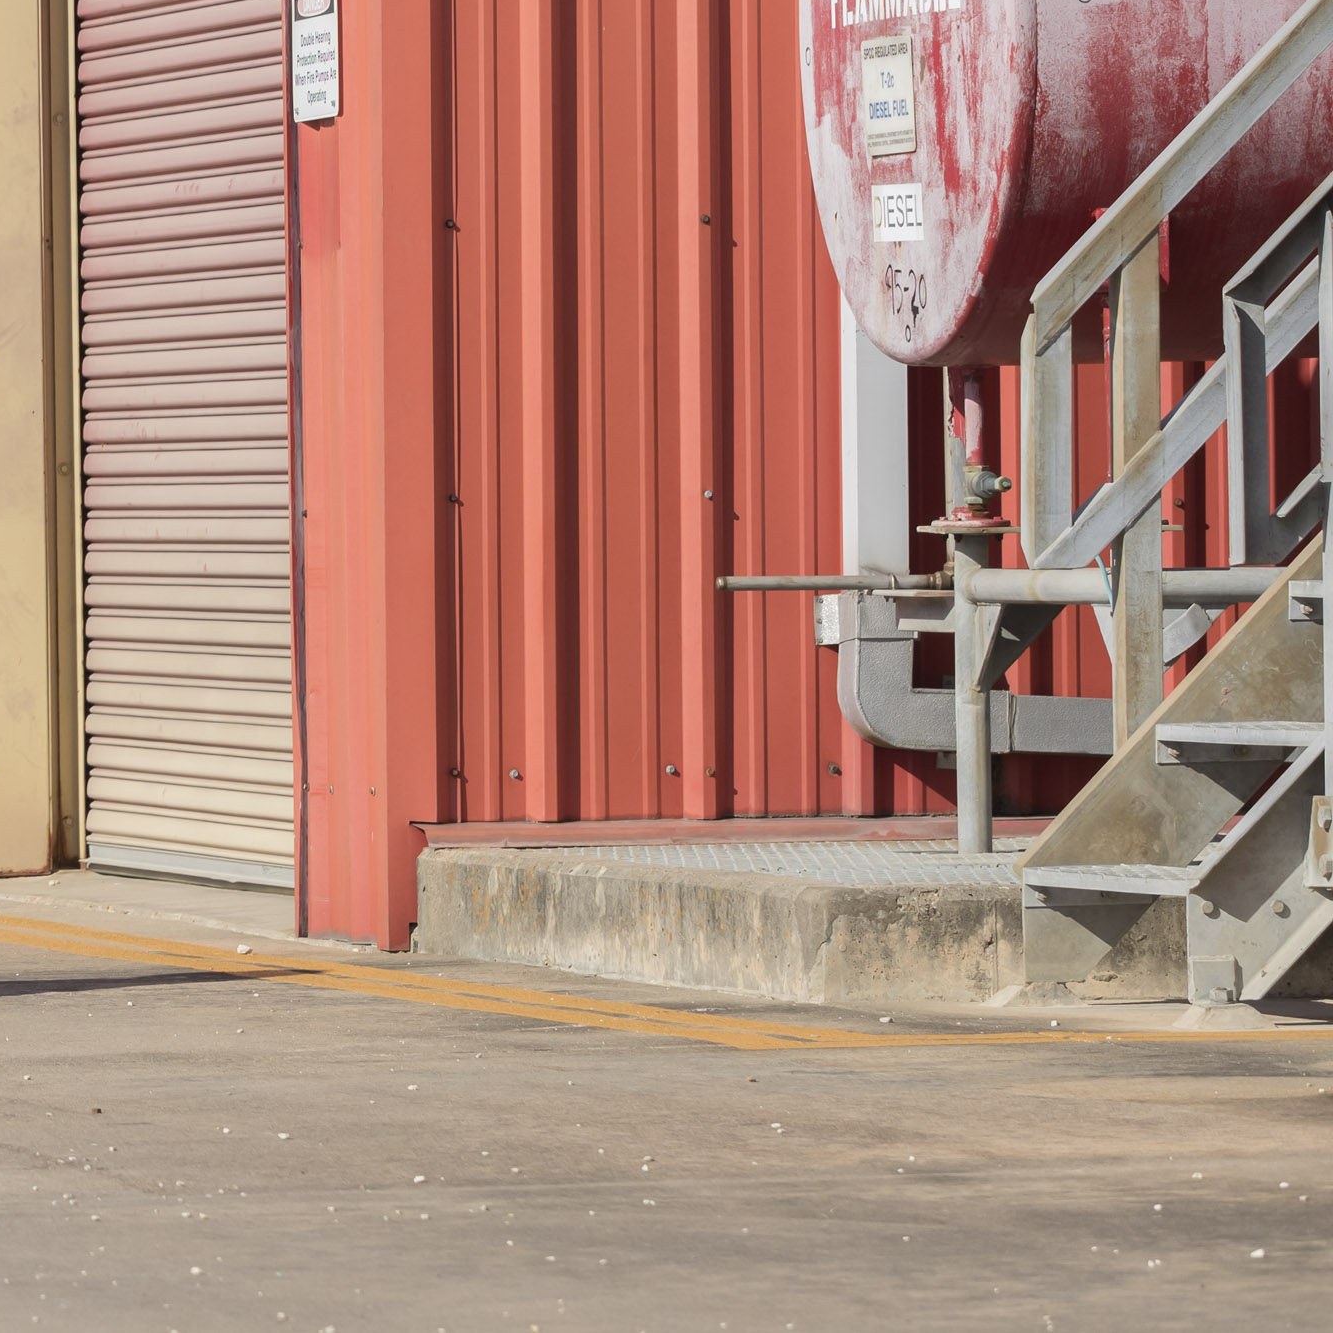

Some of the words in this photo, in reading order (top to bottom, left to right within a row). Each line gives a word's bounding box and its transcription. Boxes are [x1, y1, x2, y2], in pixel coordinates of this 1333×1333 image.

[300, 33, 314, 47] Double
[315, 30, 331, 46] Hearing
[296, 53, 316, 68] Protection
[317, 50, 335, 66] Required
[874, 43, 897, 58] REGULATED
[897, 42, 908, 55] AREA
[295, 73, 306, 86] When
[306, 71, 315, 84] Fire
[315, 69, 329, 84] Pumps
[329, 68, 337, 80] Are
[880, 71, 894, 88] T-2c
[307, 90, 326, 104] Operating
[869, 100, 892, 120] DIESEL
[893, 98, 909, 117] FUEL
[874, 194, 923, 228] DIESEL
[885, 264, 927, 317] 95-20
